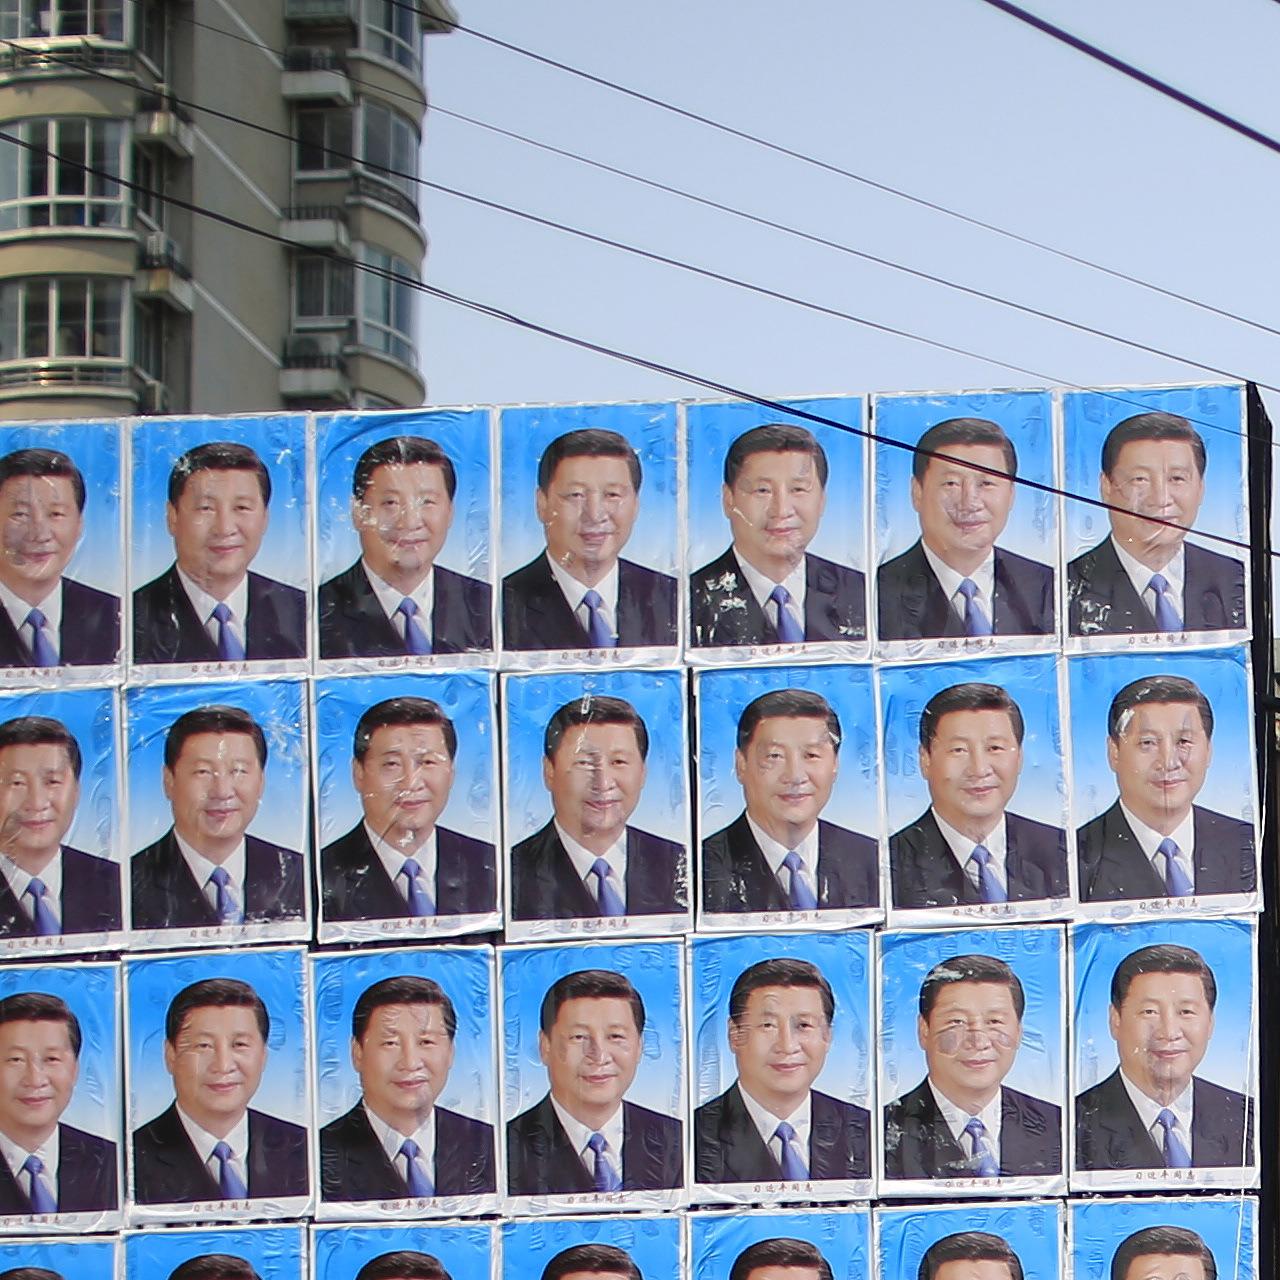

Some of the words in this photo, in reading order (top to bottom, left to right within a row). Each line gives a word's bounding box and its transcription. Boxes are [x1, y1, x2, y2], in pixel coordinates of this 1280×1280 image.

[937, 636, 998, 650] 习近平同志
[561, 649, 622, 661] 习近平同志
[190, 662, 251, 674] 习近平同志
[377, 656, 438, 669] 习近平同志
[1138, 897, 1201, 911] 习近平同志
[380, 918, 441, 931] 习近平同志
[6, 936, 67, 950] 习近平同志
[1134, 1170, 1197, 1181] 习近平同志
[753, 1181, 814, 1194] 习近平同志
[192, 1201, 253, 1213] 习近平同志
